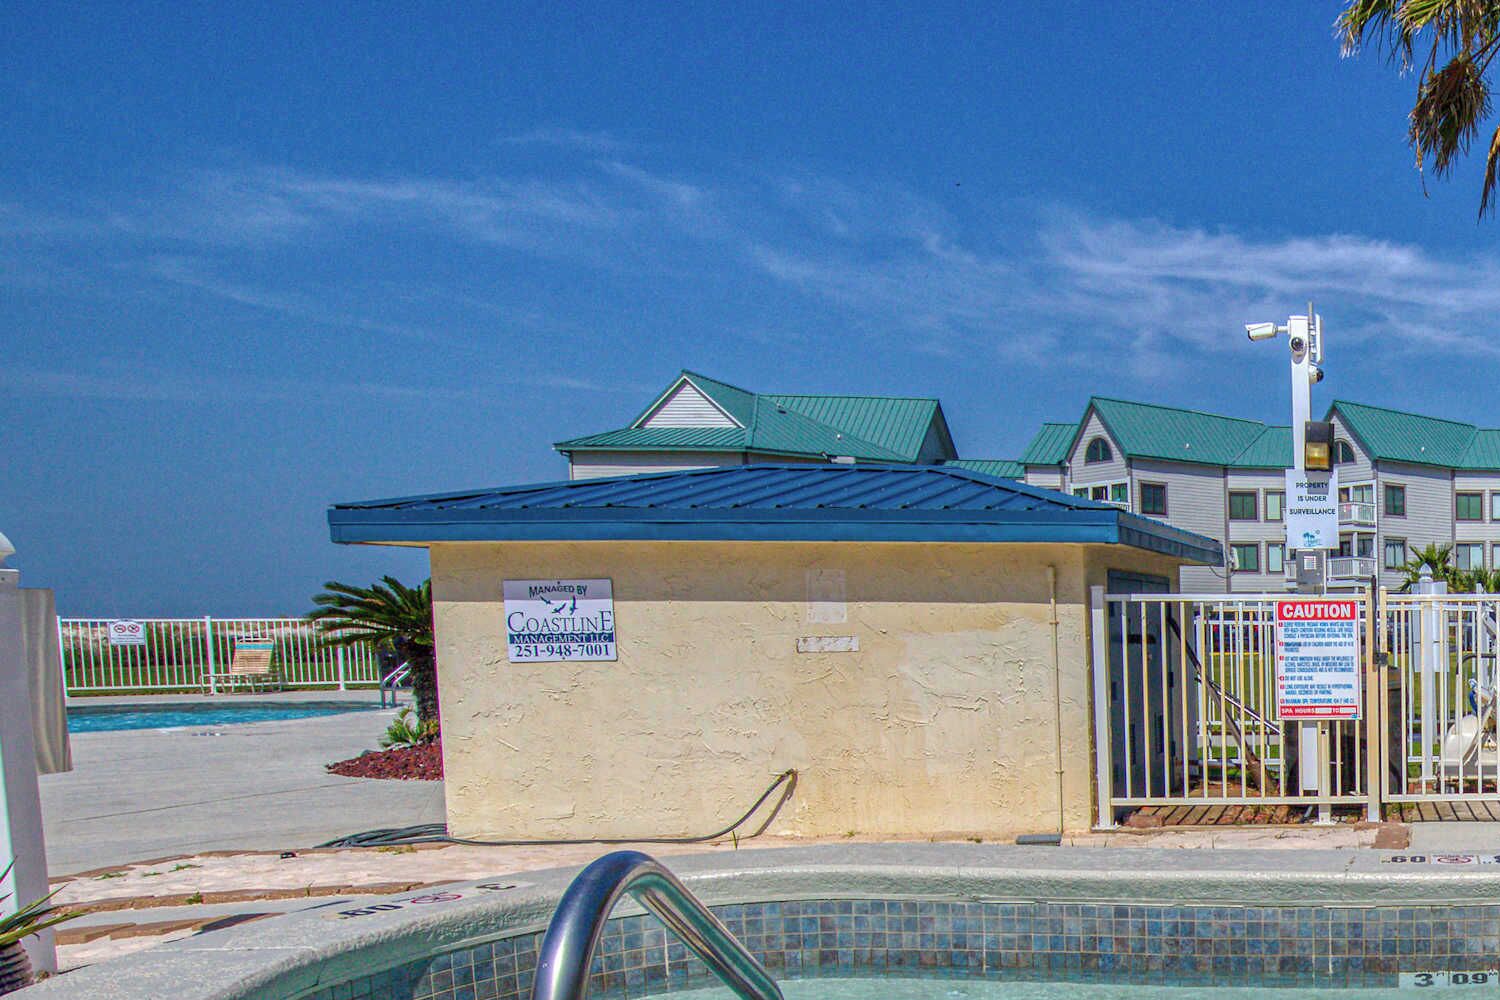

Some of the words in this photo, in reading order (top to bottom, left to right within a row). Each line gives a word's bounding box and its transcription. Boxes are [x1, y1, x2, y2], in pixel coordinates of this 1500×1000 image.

[528, 585, 575, 598] MANAGED
[576, 585, 588, 597] BY
[1282, 604, 1351, 618] CAUTION
[507, 610, 613, 633] COASTLINE
[512, 633, 585, 644] MANAGEMENT
[515, 644, 610, 658] 251-948-7001
[1414, 973, 1434, 987] 3
